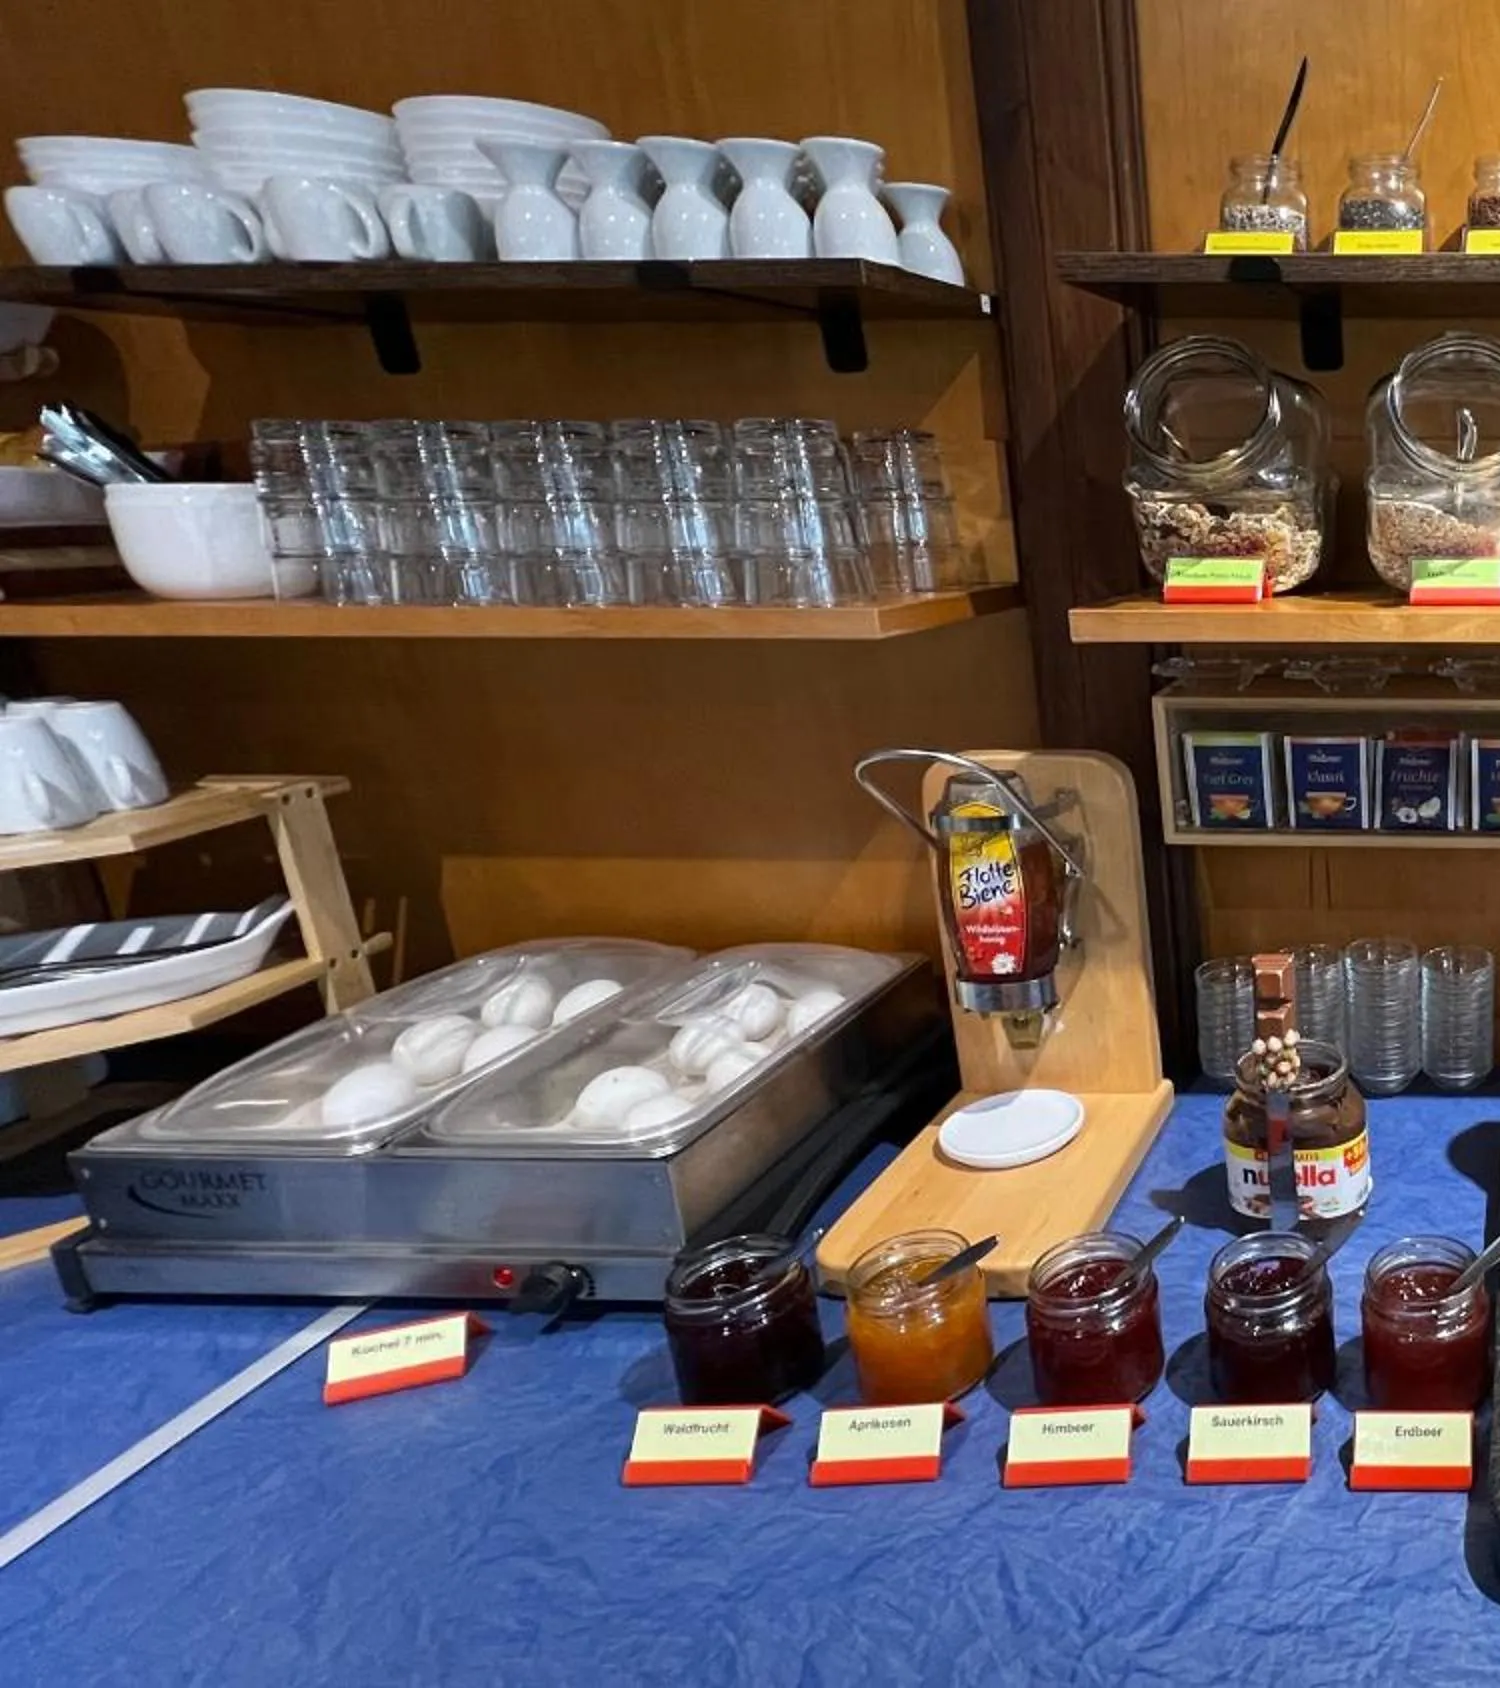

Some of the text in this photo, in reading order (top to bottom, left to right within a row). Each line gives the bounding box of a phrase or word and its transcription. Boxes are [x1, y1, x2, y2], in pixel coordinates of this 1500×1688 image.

[958, 861, 1015, 884] Flotte
[959, 879, 1015, 910] Biene
[140, 1170, 267, 1191] GOURMET
[1243, 1163, 1337, 1186] nulla
[663, 1420, 730, 1436] Waldfrucht
[848, 1416, 912, 1432] Aprikosen
[1041, 1422, 1095, 1435] Himbeer
[1211, 1414, 1284, 1428] Sauerkirsch
[1394, 1425, 1444, 1438] Erdbeer
